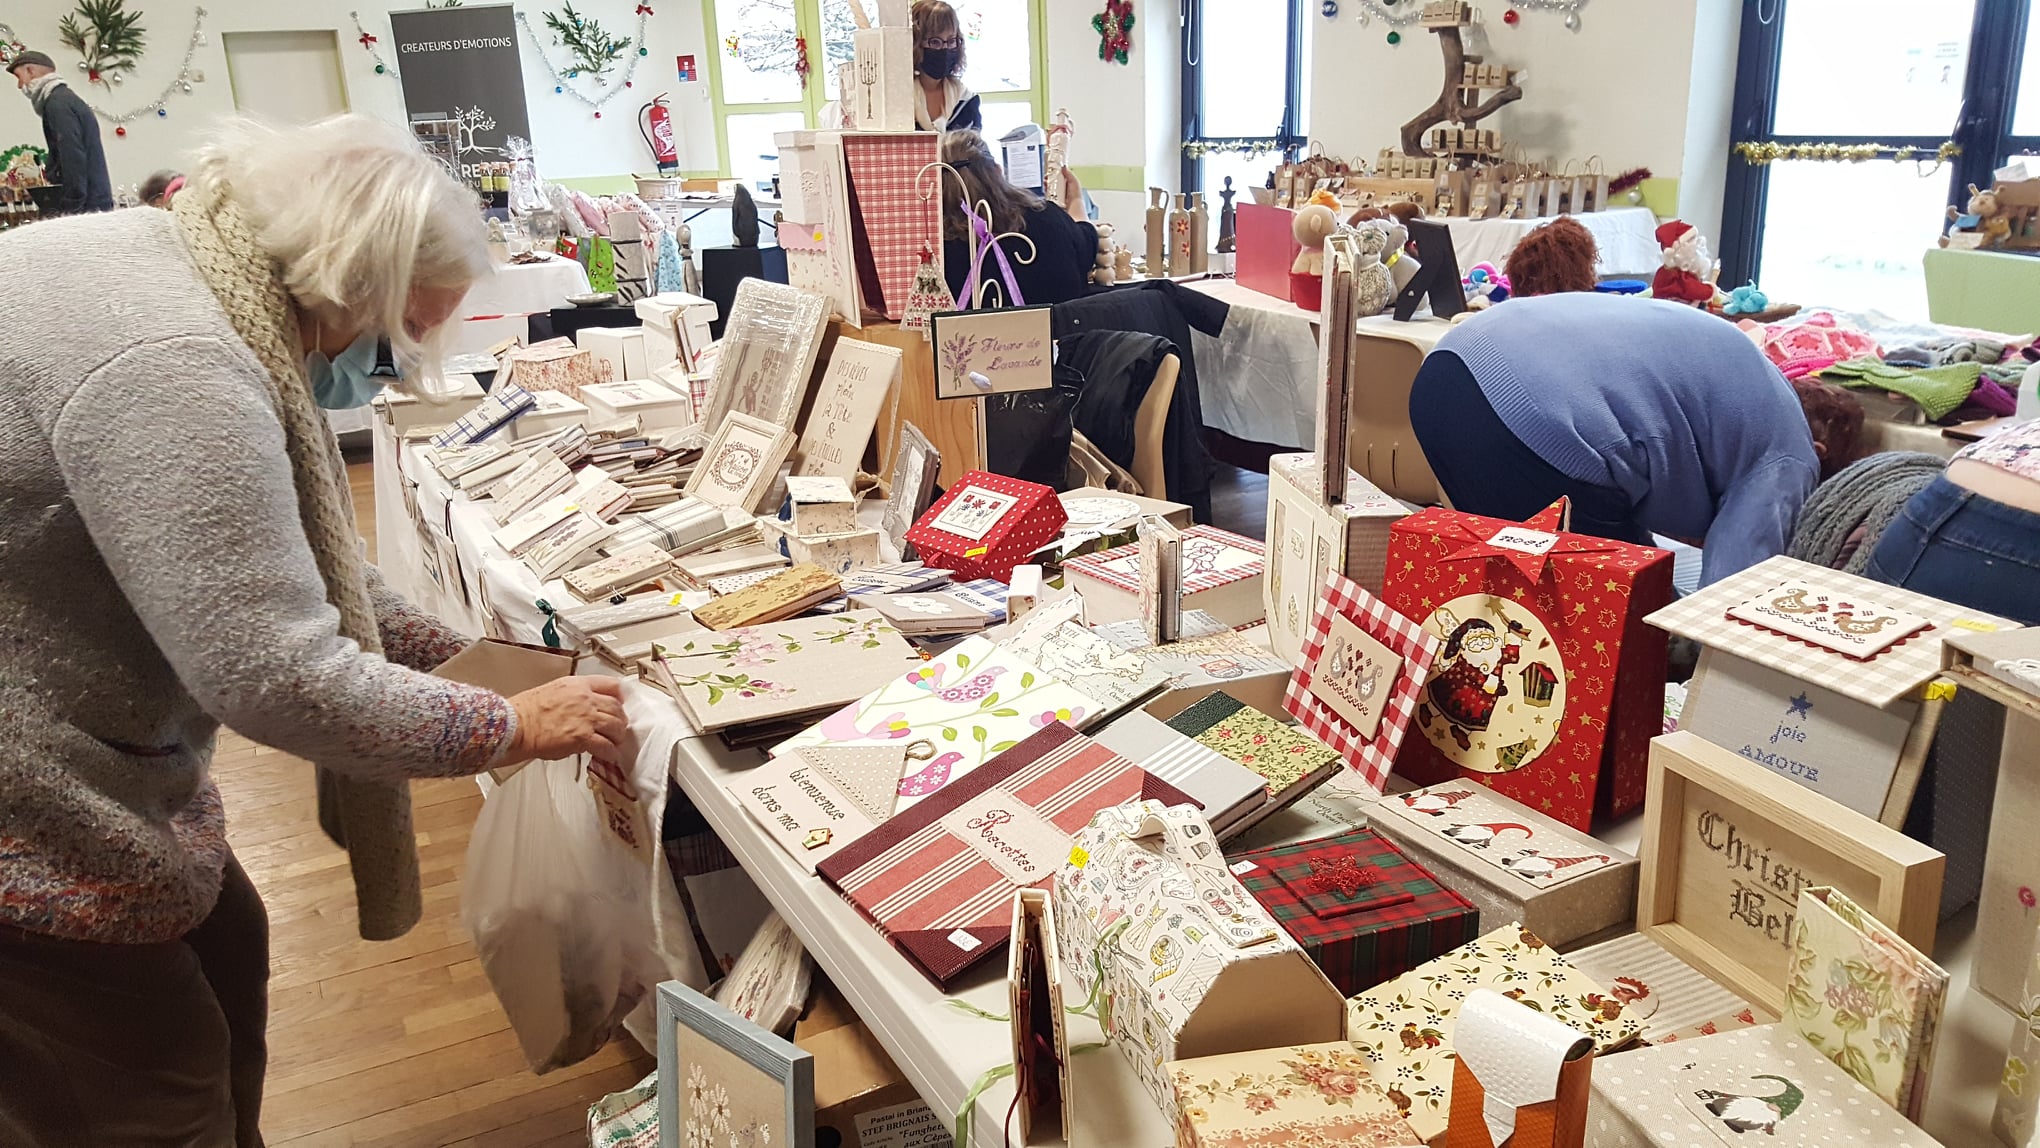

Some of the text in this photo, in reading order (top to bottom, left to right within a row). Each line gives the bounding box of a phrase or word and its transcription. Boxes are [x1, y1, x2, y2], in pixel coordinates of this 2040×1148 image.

[401, 36, 512, 54] CREATEURS D'EMOTIONS
[986, 356, 1042, 371] Lavande
[825, 421, 836, 440] &
[1769, 720, 1807, 744] joie
[1738, 744, 1819, 782] AMOUR
[752, 785, 801, 832] dans ma
[789, 766, 845, 821] bienvenue
[966, 809, 1036, 873] Recettes
[1697, 810, 1813, 902] Christ
[1730, 878, 1794, 951] Bel
[862, 1124, 886, 1138] STEF
[886, 1114, 930, 1133] BRIGNAIS
[897, 1108, 905, 1118] in
